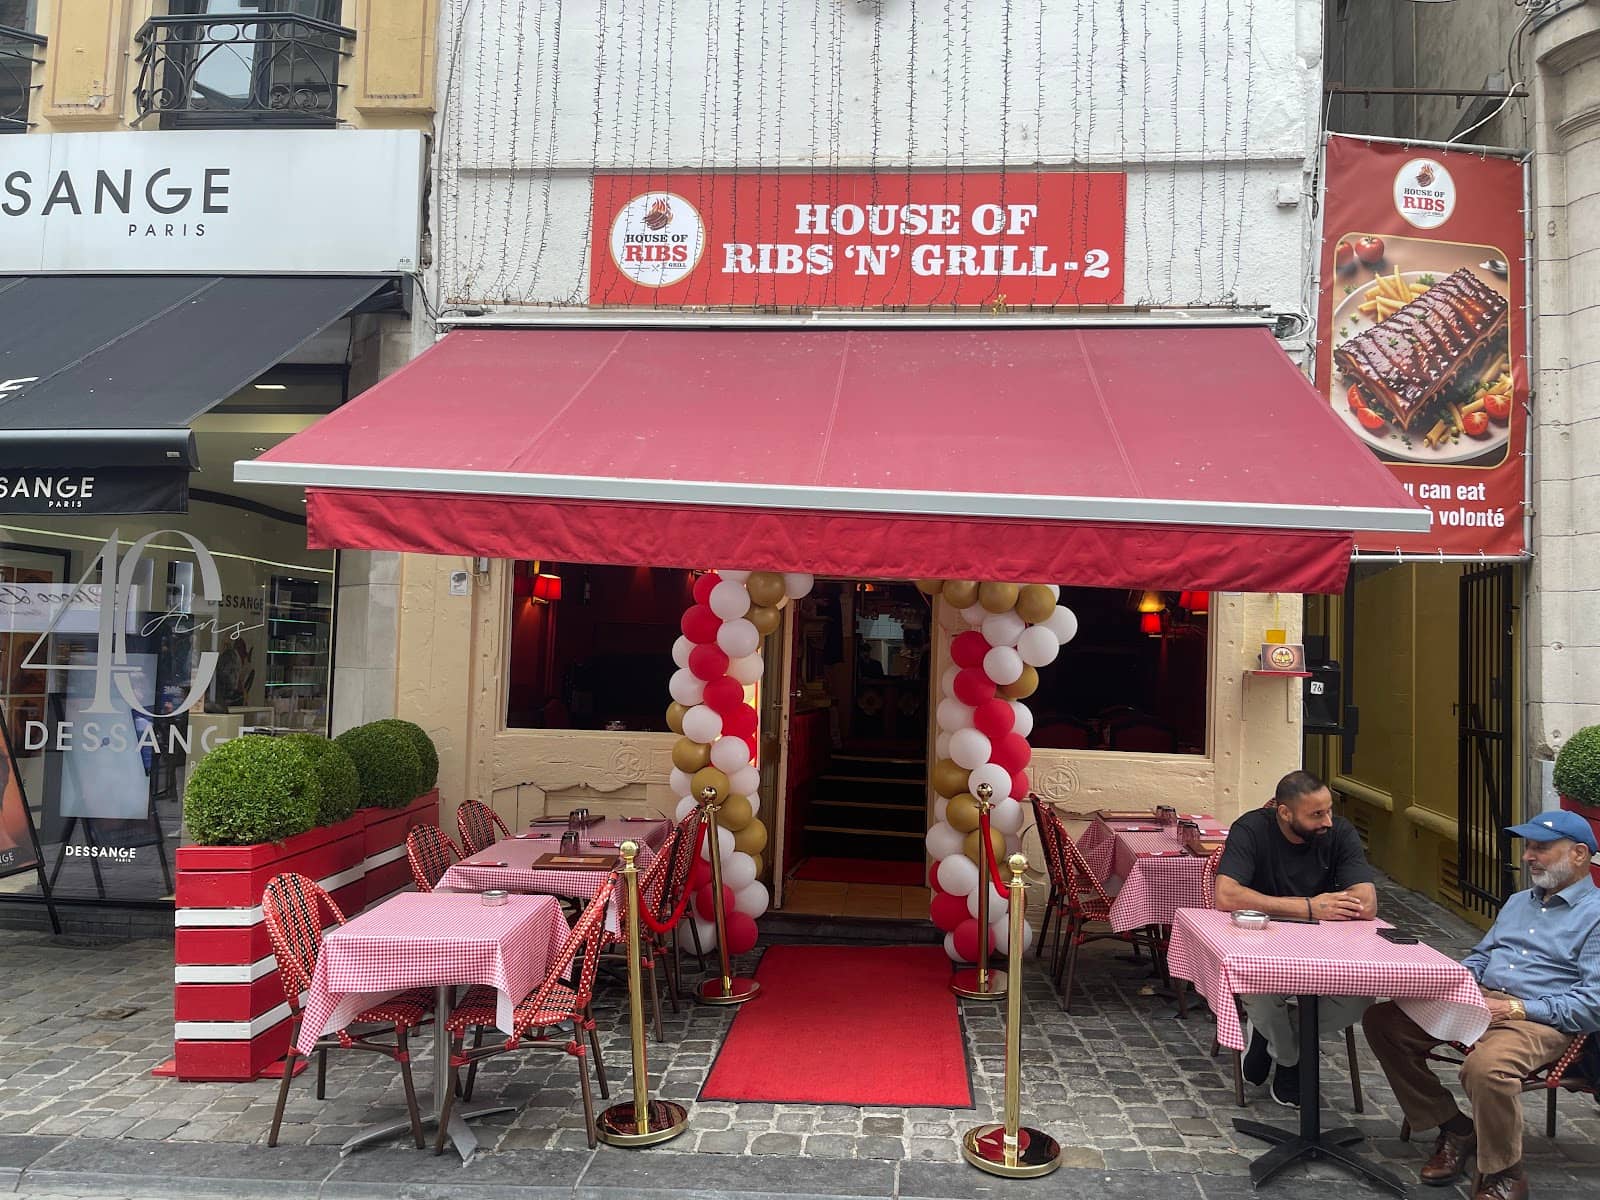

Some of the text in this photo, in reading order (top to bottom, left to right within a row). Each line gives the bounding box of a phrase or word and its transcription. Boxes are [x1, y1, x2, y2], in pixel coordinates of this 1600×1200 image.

[1, 168, 230, 216] SANGE
[1404, 188, 1432, 197] HOUSE
[1403, 196, 1445, 212] RIBS
[795, 204, 1038, 235] HOUSE OF
[128, 223, 205, 237] PARIS
[626, 234, 688, 243] HOUSE OF
[625, 244, 688, 263] RIBS
[721, 243, 834, 275] RIBS
[1419, 483, 1451, 499] can
[1456, 483, 1486, 501] eat
[48, 500, 82, 508] PARIS
[1438, 506, 1505, 527] volonté
[21, 528, 222, 718] 40
[1312, 683, 1322, 692] 76
[65, 845, 136, 858] DESSANGE
